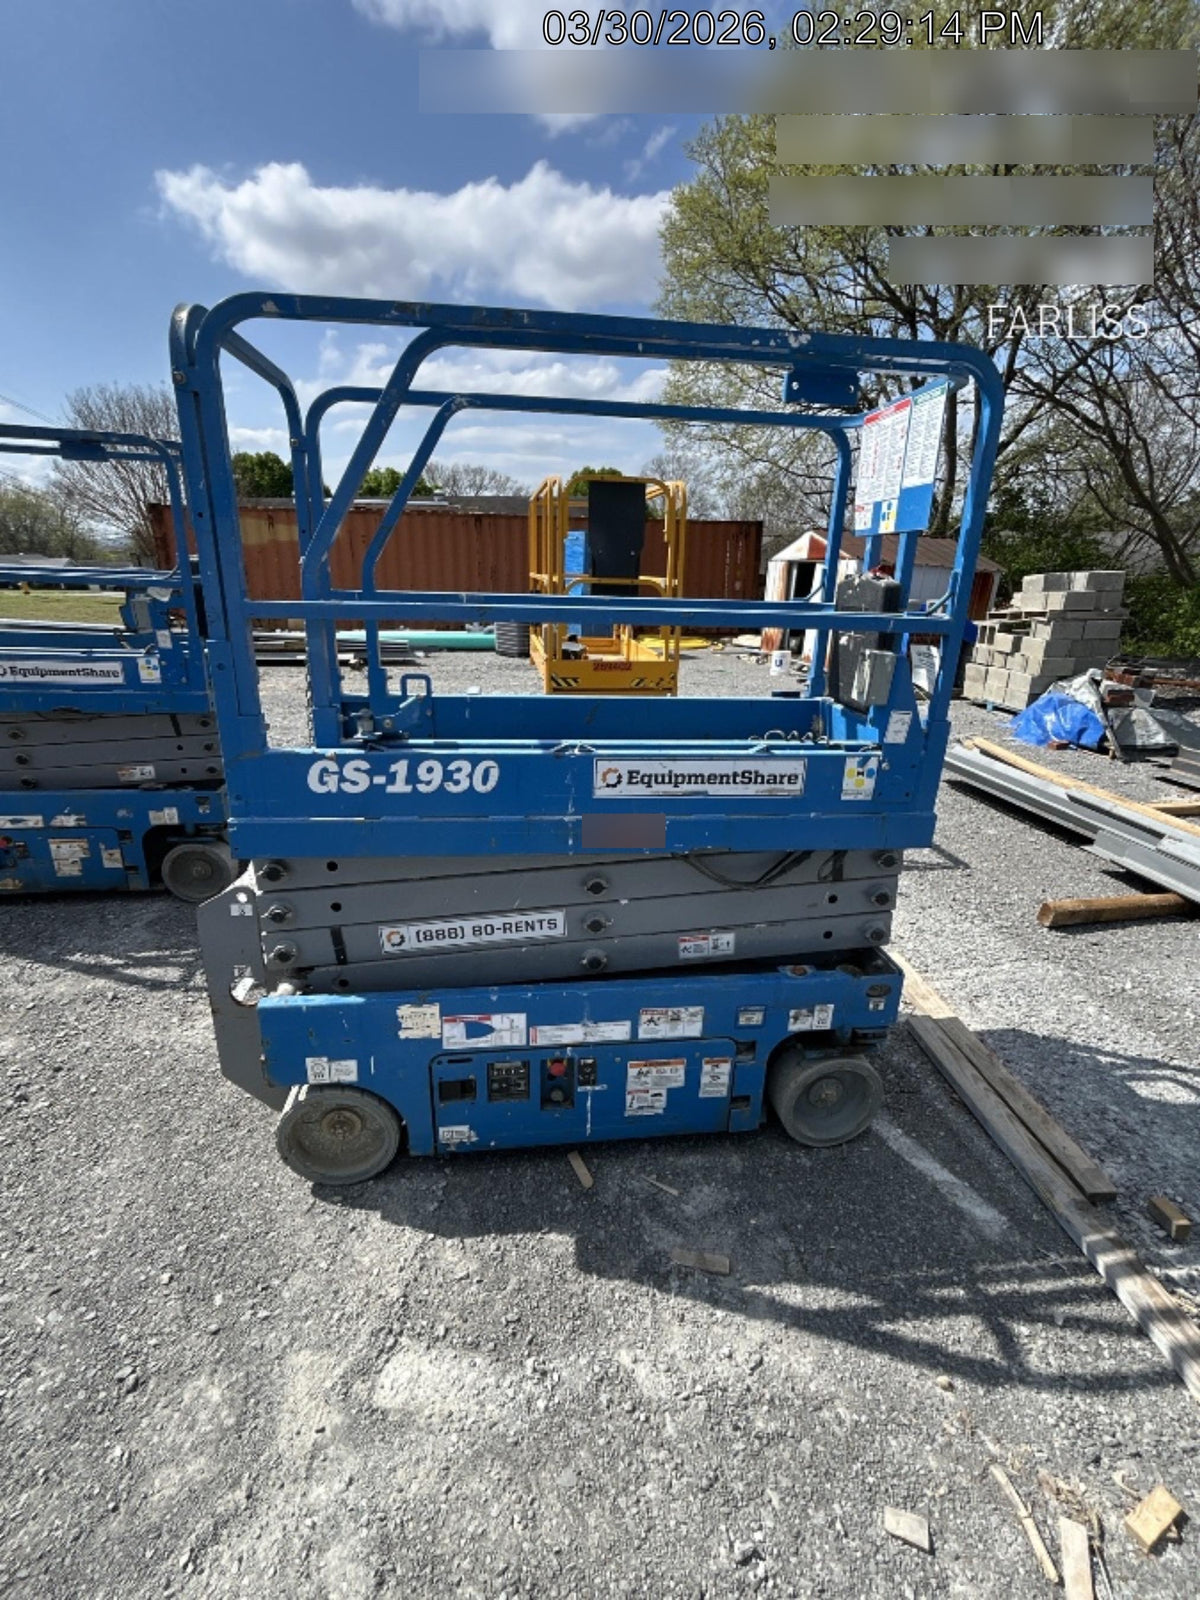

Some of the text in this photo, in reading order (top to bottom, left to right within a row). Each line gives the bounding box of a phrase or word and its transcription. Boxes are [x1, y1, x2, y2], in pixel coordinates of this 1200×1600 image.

[8, 666, 120, 678] EquipmentShare
[306, 759, 500, 794] GS-1930
[626, 768, 799, 788] EquipmentShare
[471, 918, 558, 937] 80-RENTS
